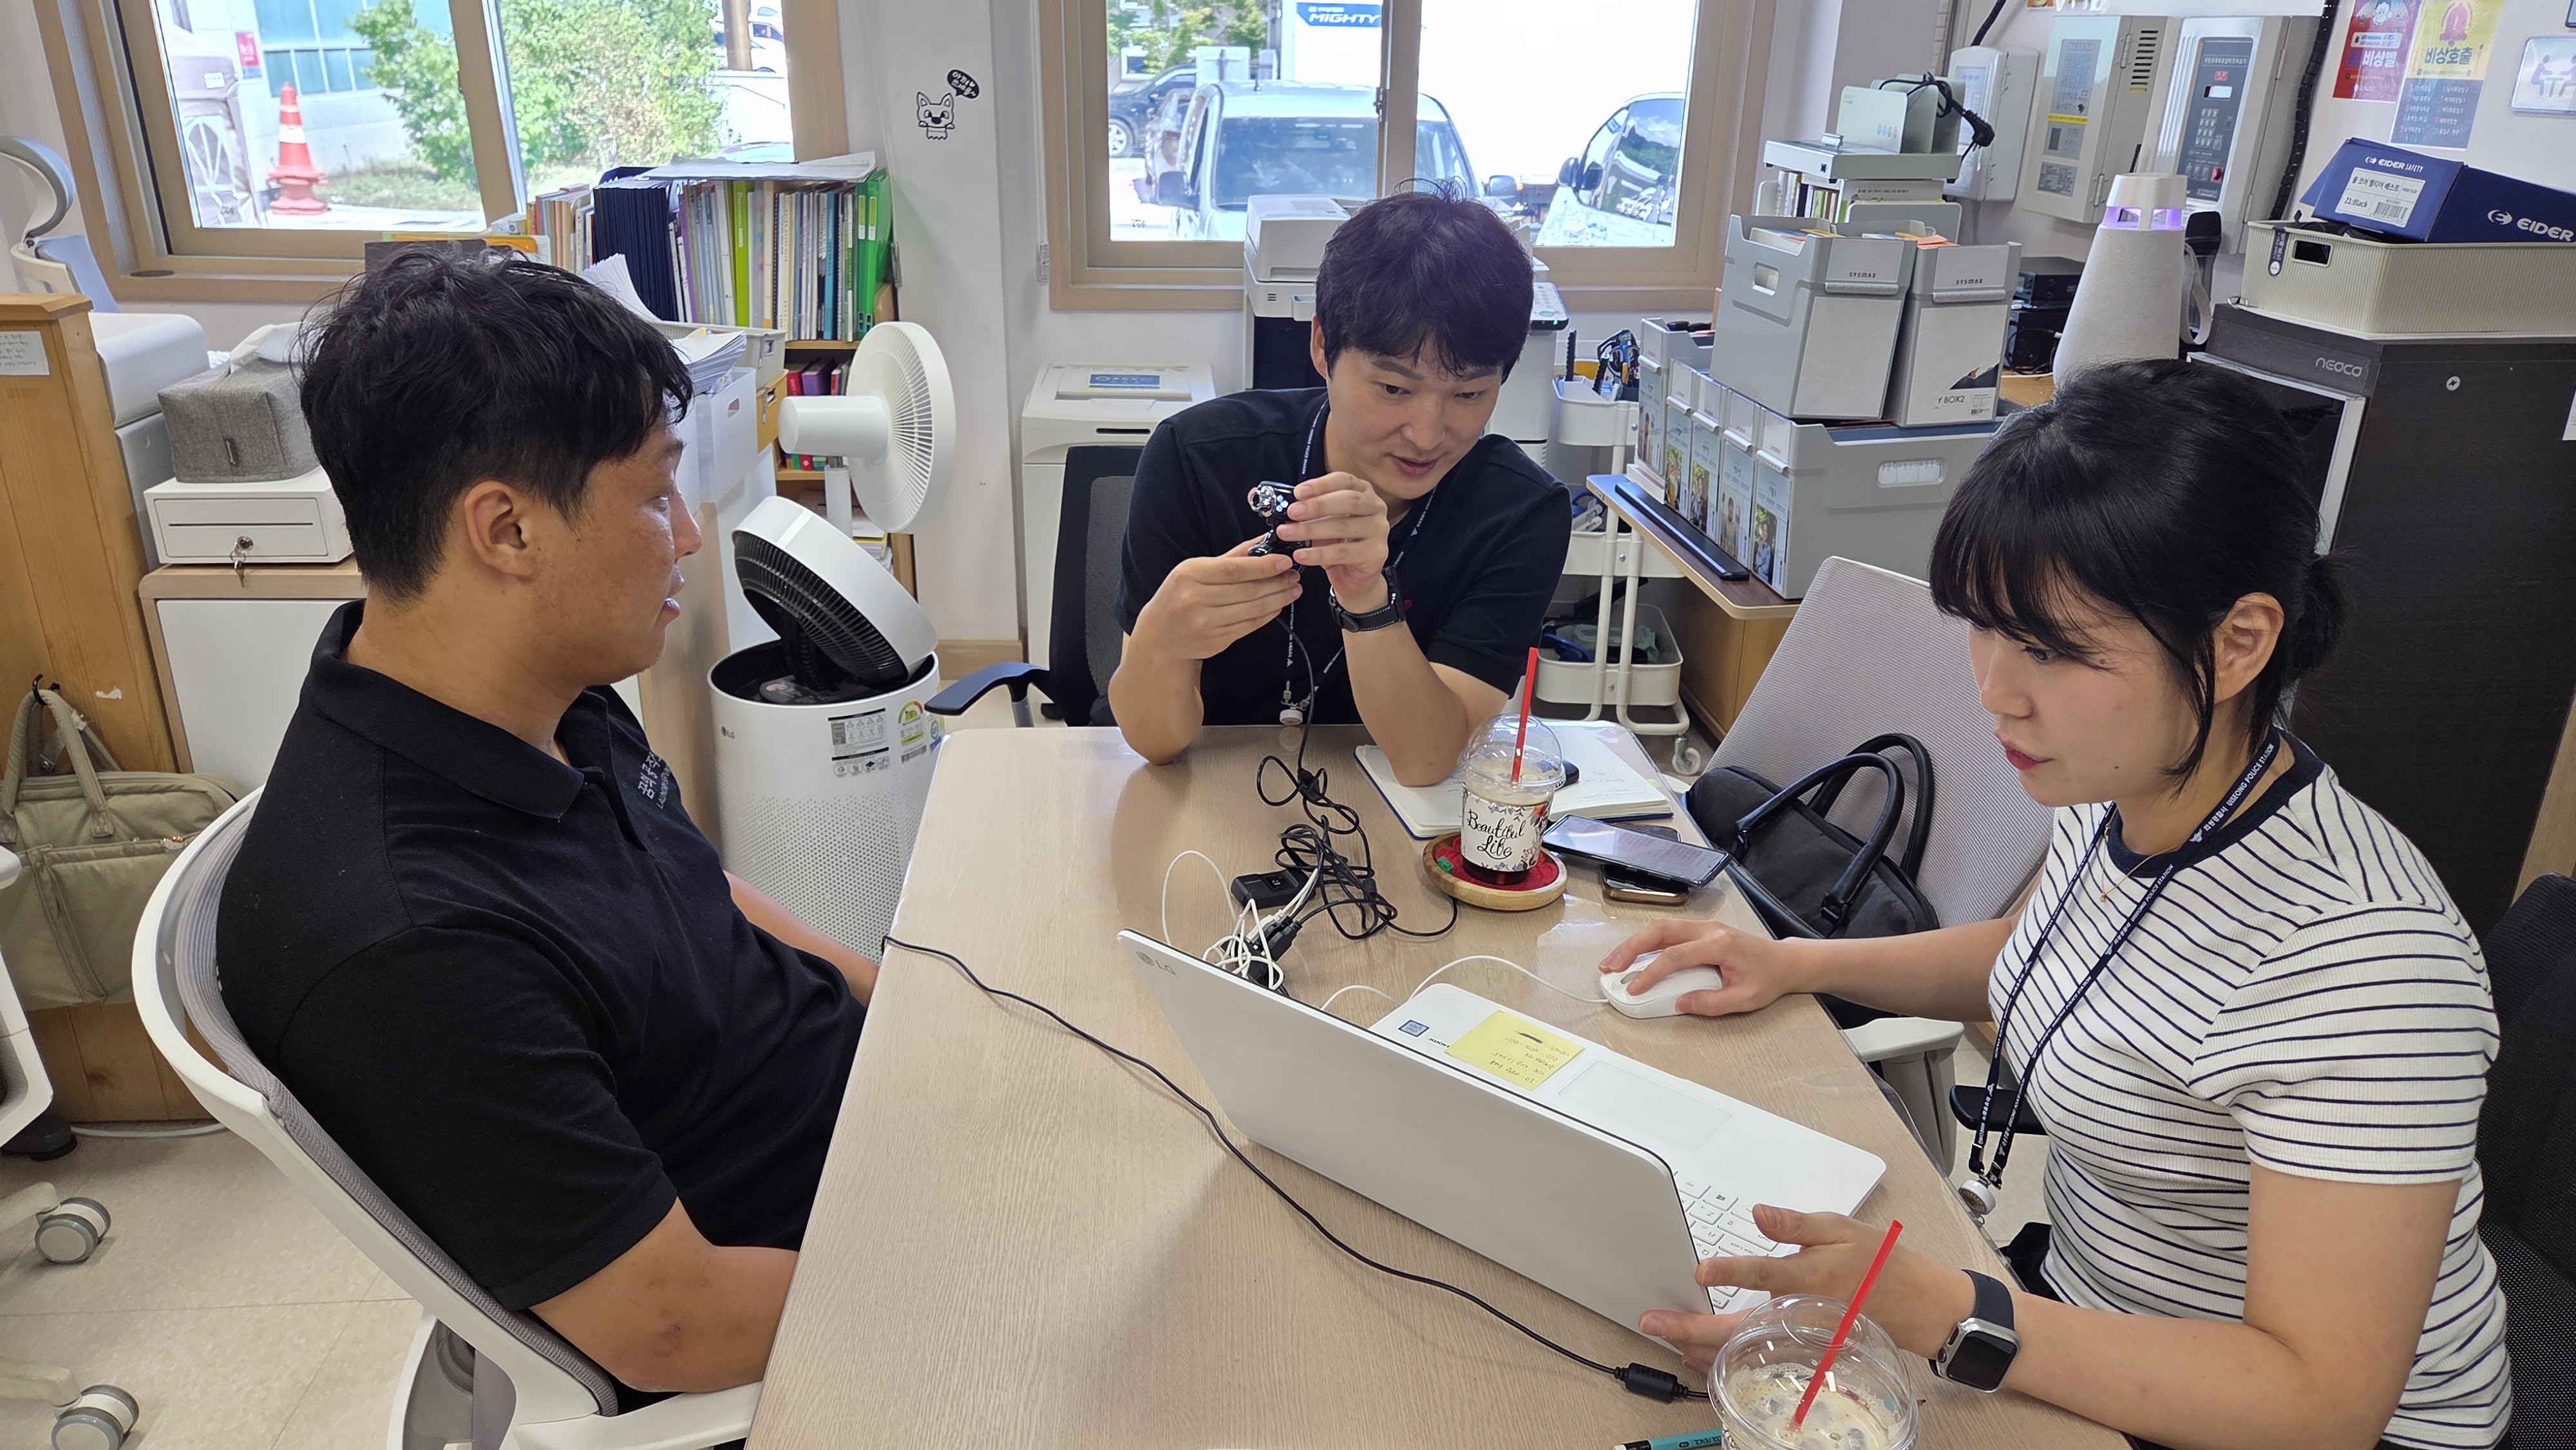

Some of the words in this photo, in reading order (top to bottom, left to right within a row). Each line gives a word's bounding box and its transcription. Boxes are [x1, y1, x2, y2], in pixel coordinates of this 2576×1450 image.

[1309, 14, 1381, 24] MIGHTY
[2362, 50, 2397, 68] 비상벨
[2425, 46, 2473, 65] 비상호출
[2378, 159, 2406, 170] EIDER
[2405, 163, 2424, 173] SAFETY
[2344, 197, 2368, 208] Z1:Black
[2517, 218, 2574, 242] EIDER
[1944, 395, 1965, 404] BOX2
[726, 730, 735, 739] LG
[2203, 806, 2228, 831] 의성경찰서
[2226, 782, 2248, 806] UISEONG
[2244, 762, 2262, 783] POLICE
[2259, 743, 2275, 764] STATION
[1467, 809, 1526, 839] Beautiful
[1477, 835, 1513, 860] Life
[2146, 884, 2159, 901] POLICE
[2157, 864, 2174, 885] STATION
[1155, 959, 1177, 975] LG
[1693, 1437, 1712, 1445] PENCIL
